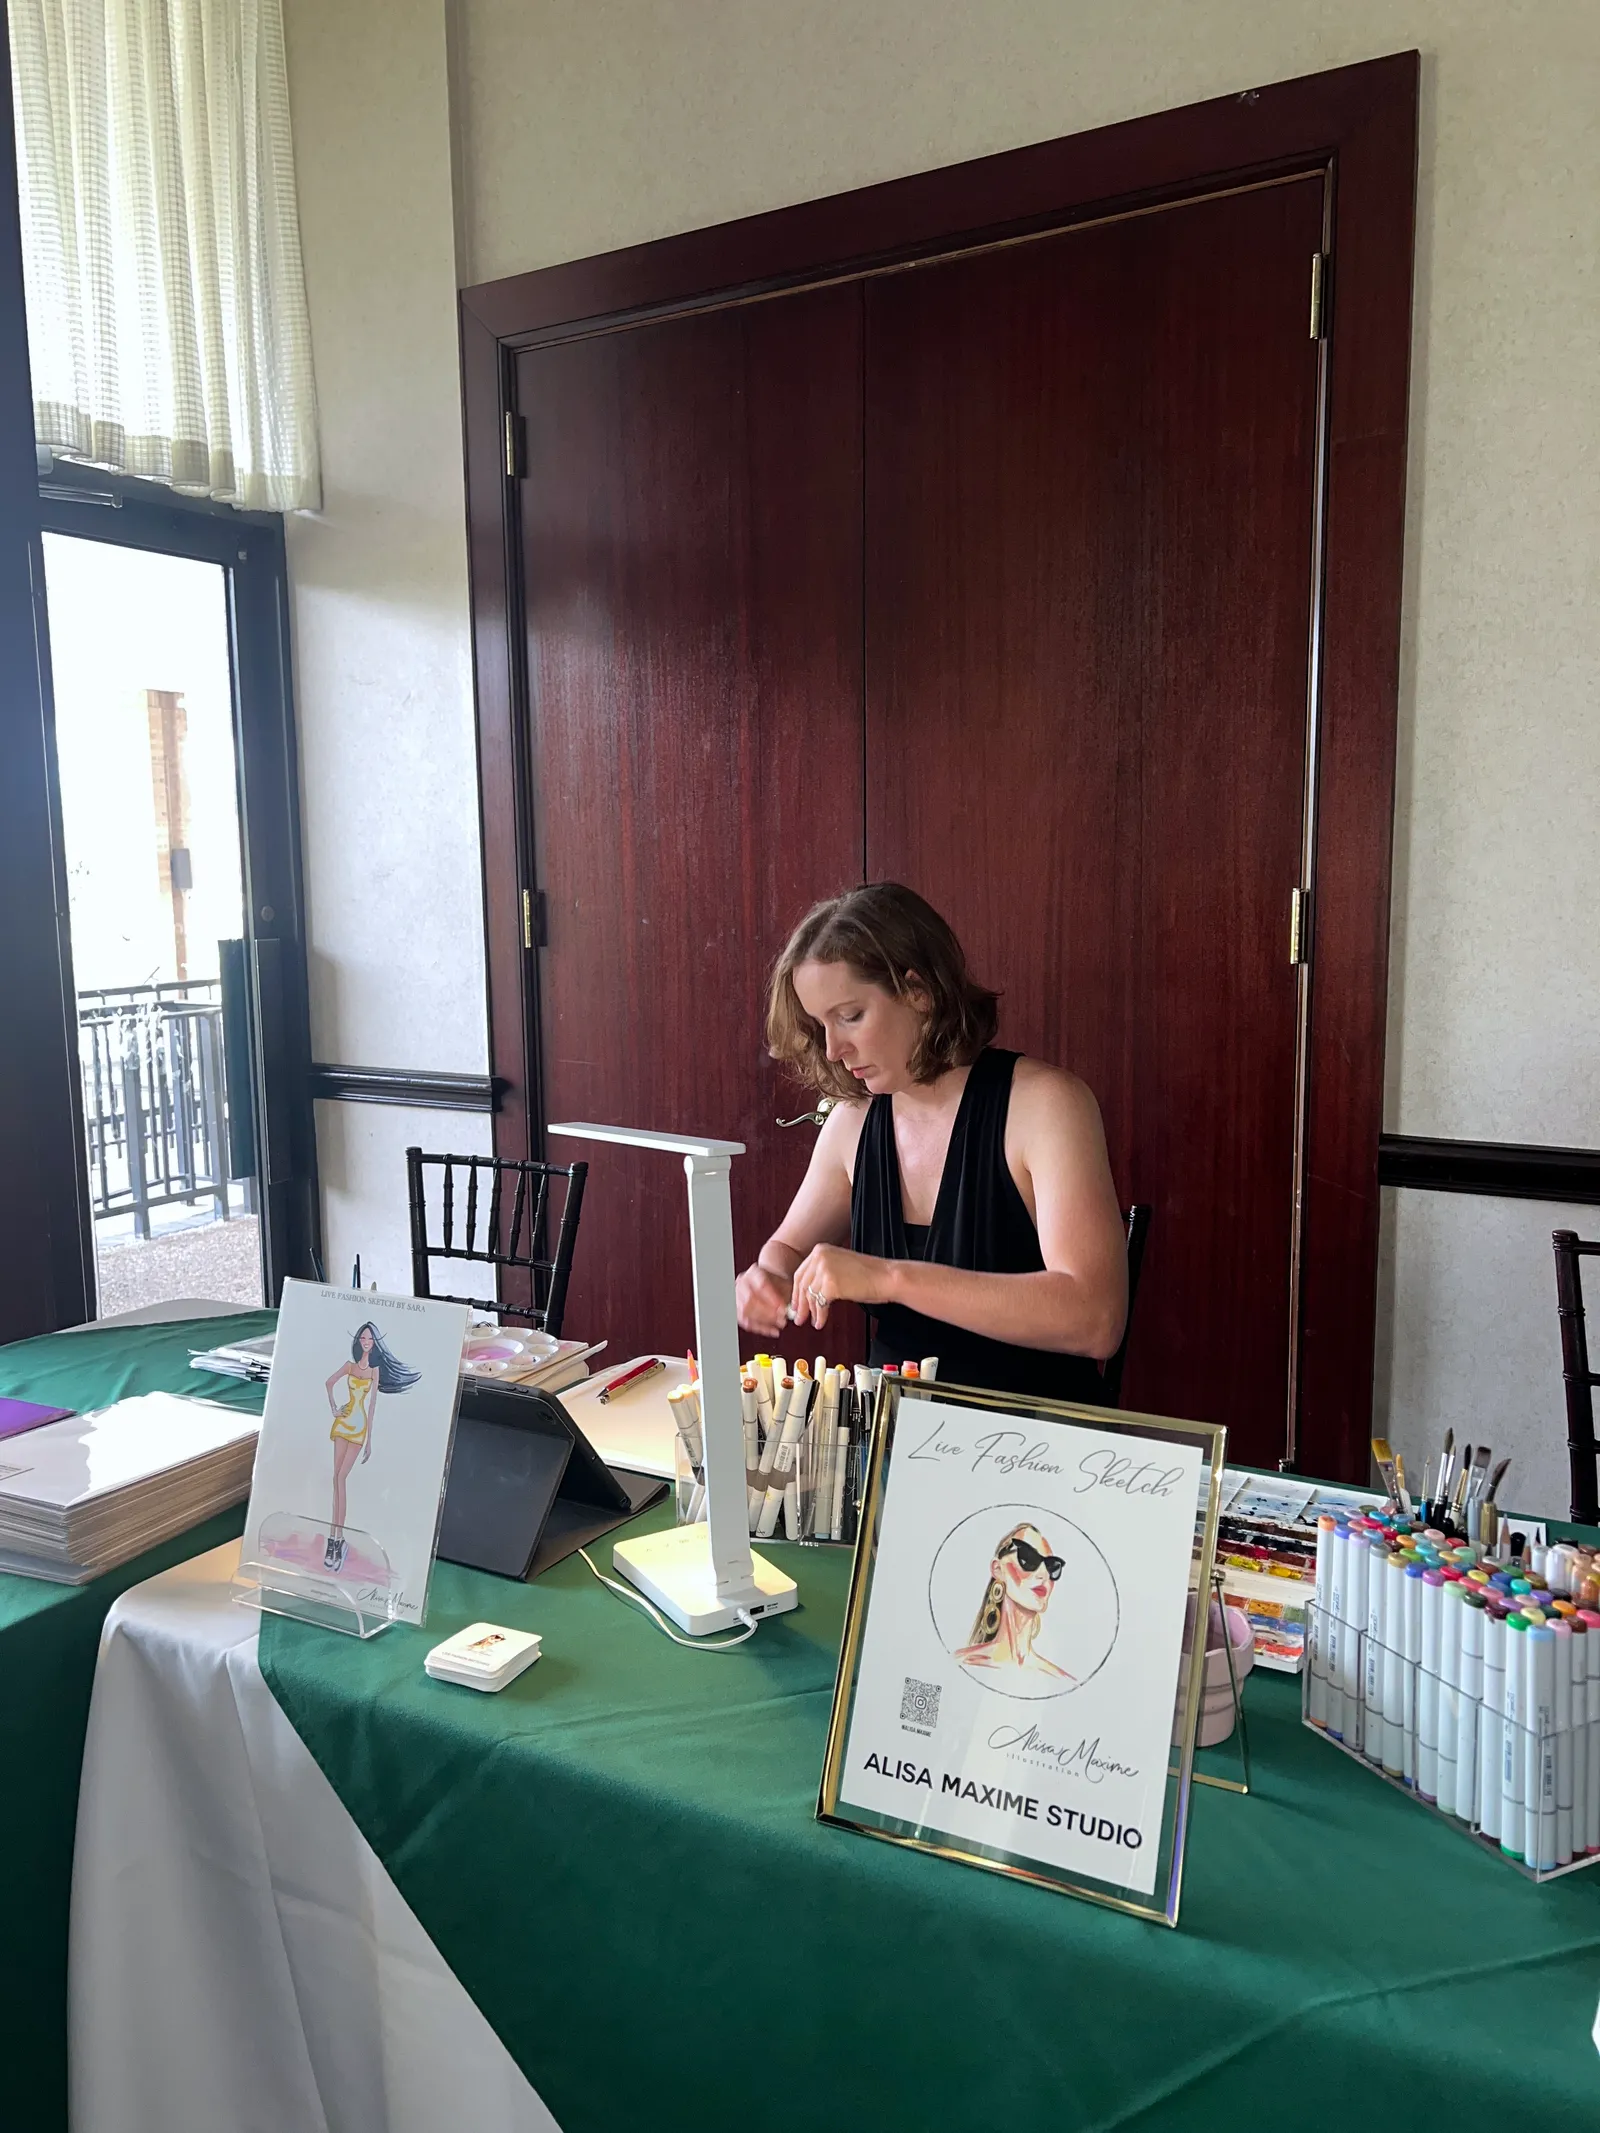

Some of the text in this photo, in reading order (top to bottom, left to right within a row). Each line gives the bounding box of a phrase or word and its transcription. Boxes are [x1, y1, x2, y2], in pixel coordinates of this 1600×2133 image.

[320, 1289, 426, 1313] LIVE FASHION SKETCH BY SARA
[907, 1420, 1185, 1497] Live Fashion Sketch
[987, 1723, 1140, 1784] Alisa Maxime
[863, 1752, 1143, 1850] ALISA MAXIME STUDIO
